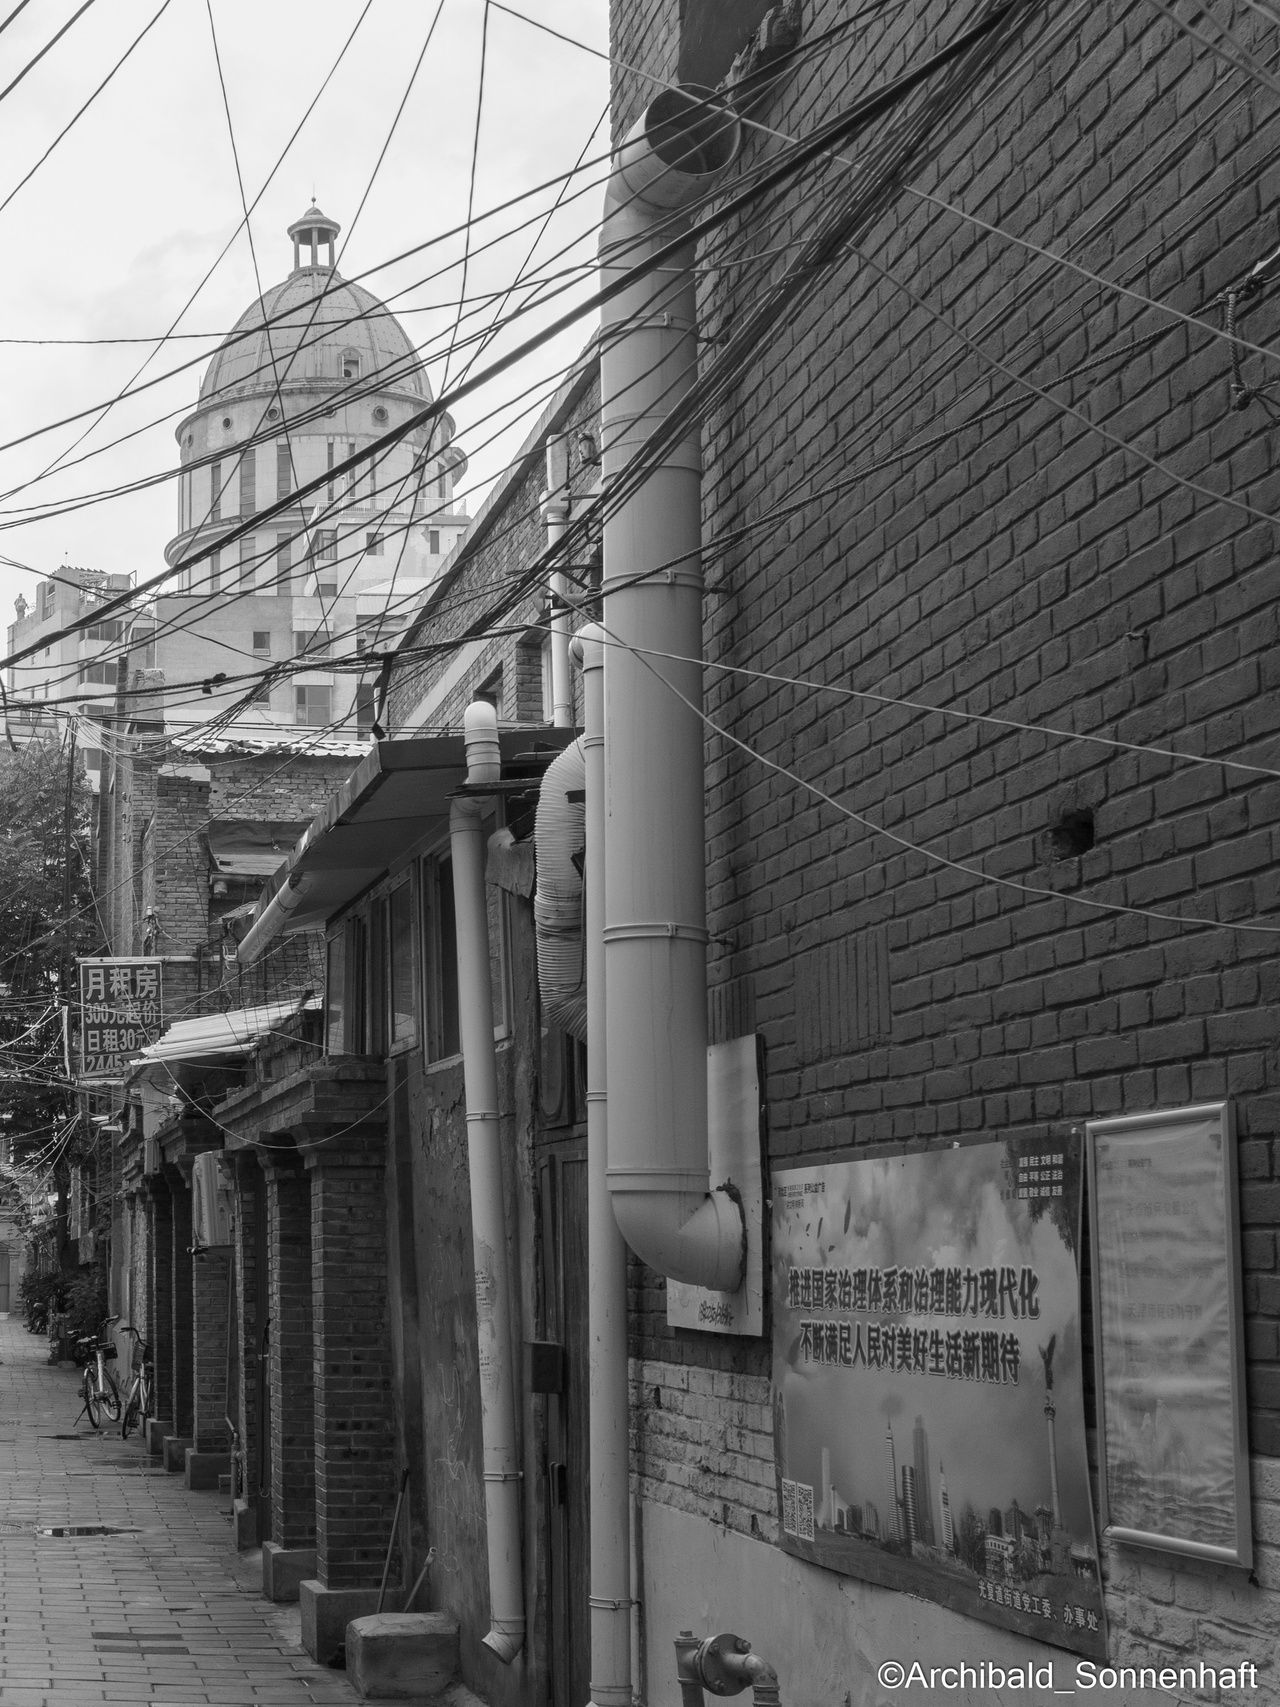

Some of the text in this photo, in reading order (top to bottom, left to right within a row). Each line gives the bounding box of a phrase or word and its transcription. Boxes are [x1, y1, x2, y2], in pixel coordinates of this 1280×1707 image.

[86, 966, 158, 1000] 月租房
[85, 1000, 159, 1024] 300元起价
[86, 1055, 129, 1076] 2445
[788, 1266, 1040, 1318] 推进国家治理体系和治理能力现代化
[800, 1319, 1020, 1384] 不断满足人民对美好生活新期待
[979, 1580, 1098, 1631] 光复道街道党工委、办事处
